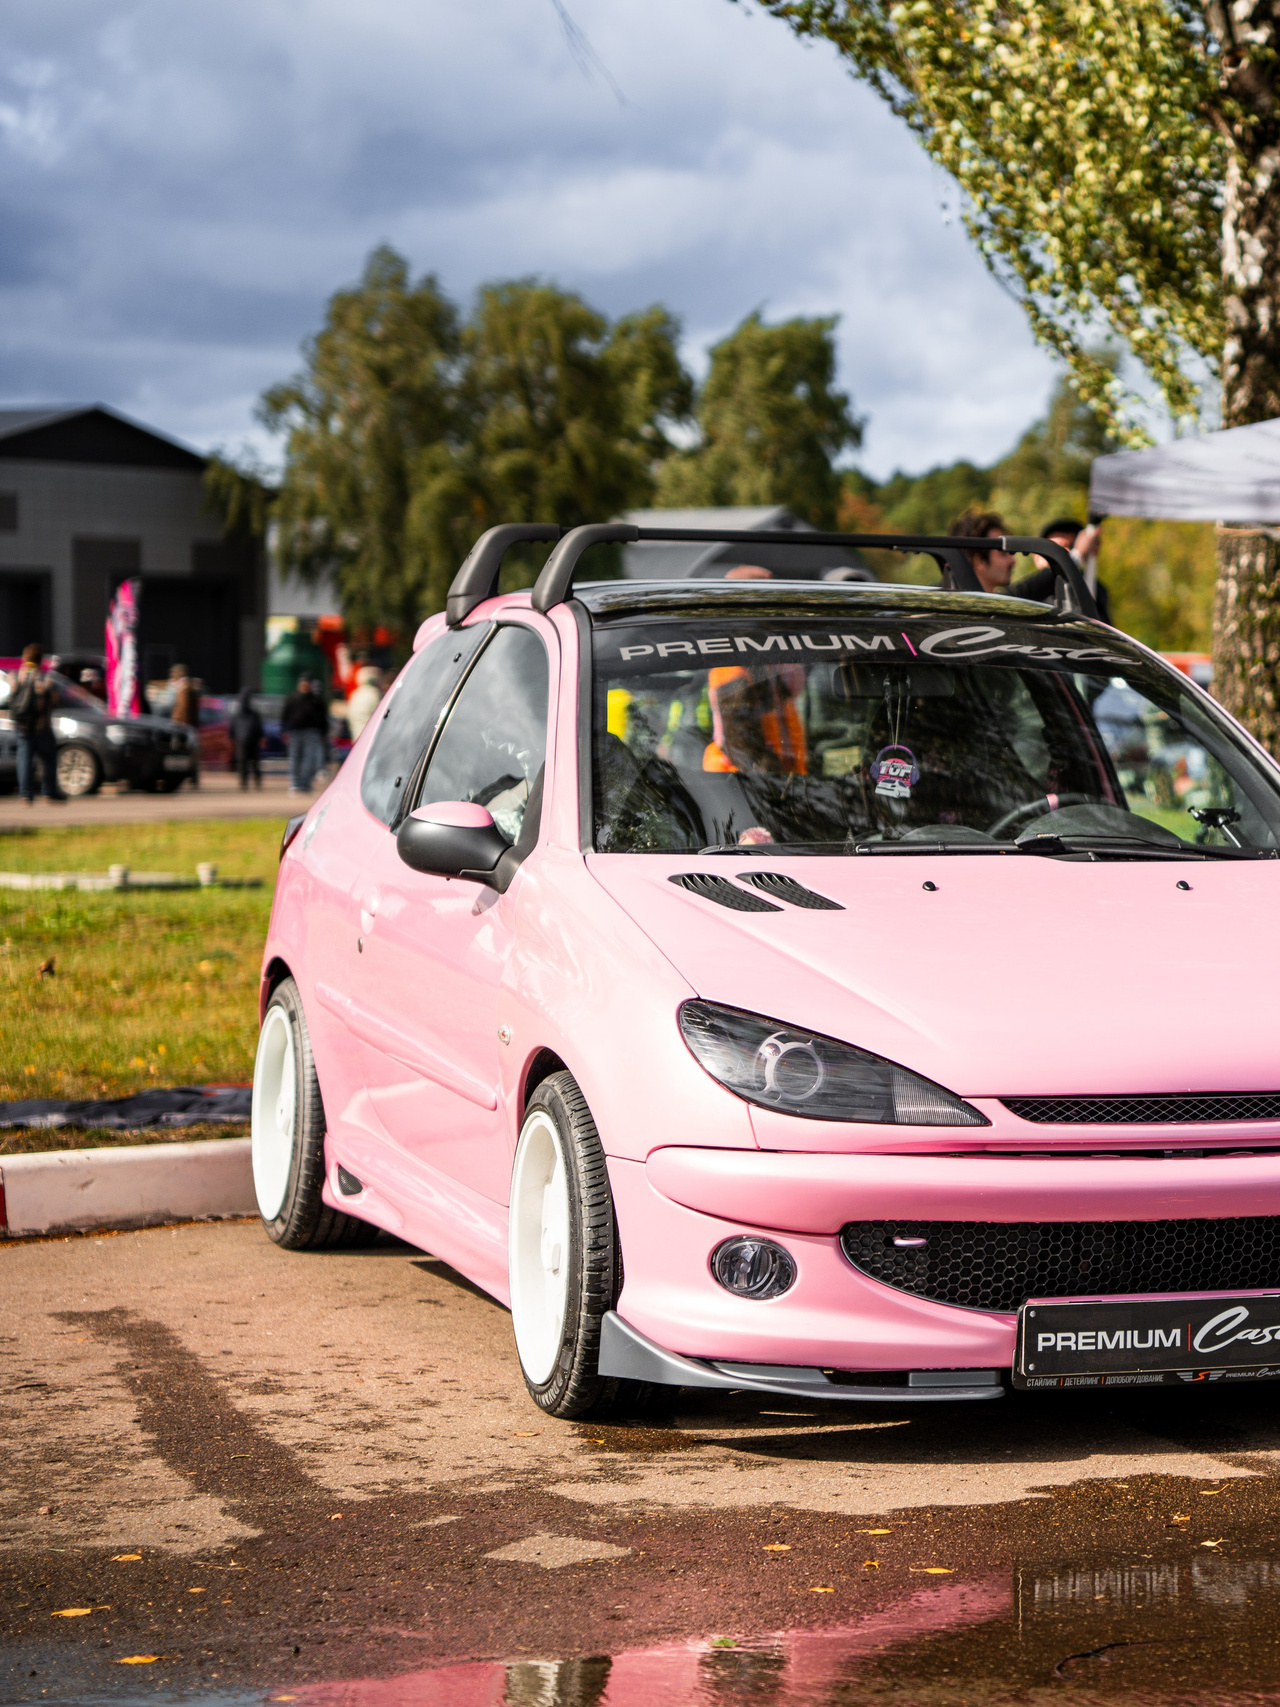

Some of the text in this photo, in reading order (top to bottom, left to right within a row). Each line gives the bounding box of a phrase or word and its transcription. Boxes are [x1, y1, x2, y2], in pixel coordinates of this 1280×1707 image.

[619, 633, 895, 661] PREMIUM
[1037, 1328, 1182, 1352] PREMIUM
[1026, 1374, 1164, 1387] СТАЙЛИНГ ДЕТЕЙЛИНГ ДОПОБОРУДОВАНИЕ
